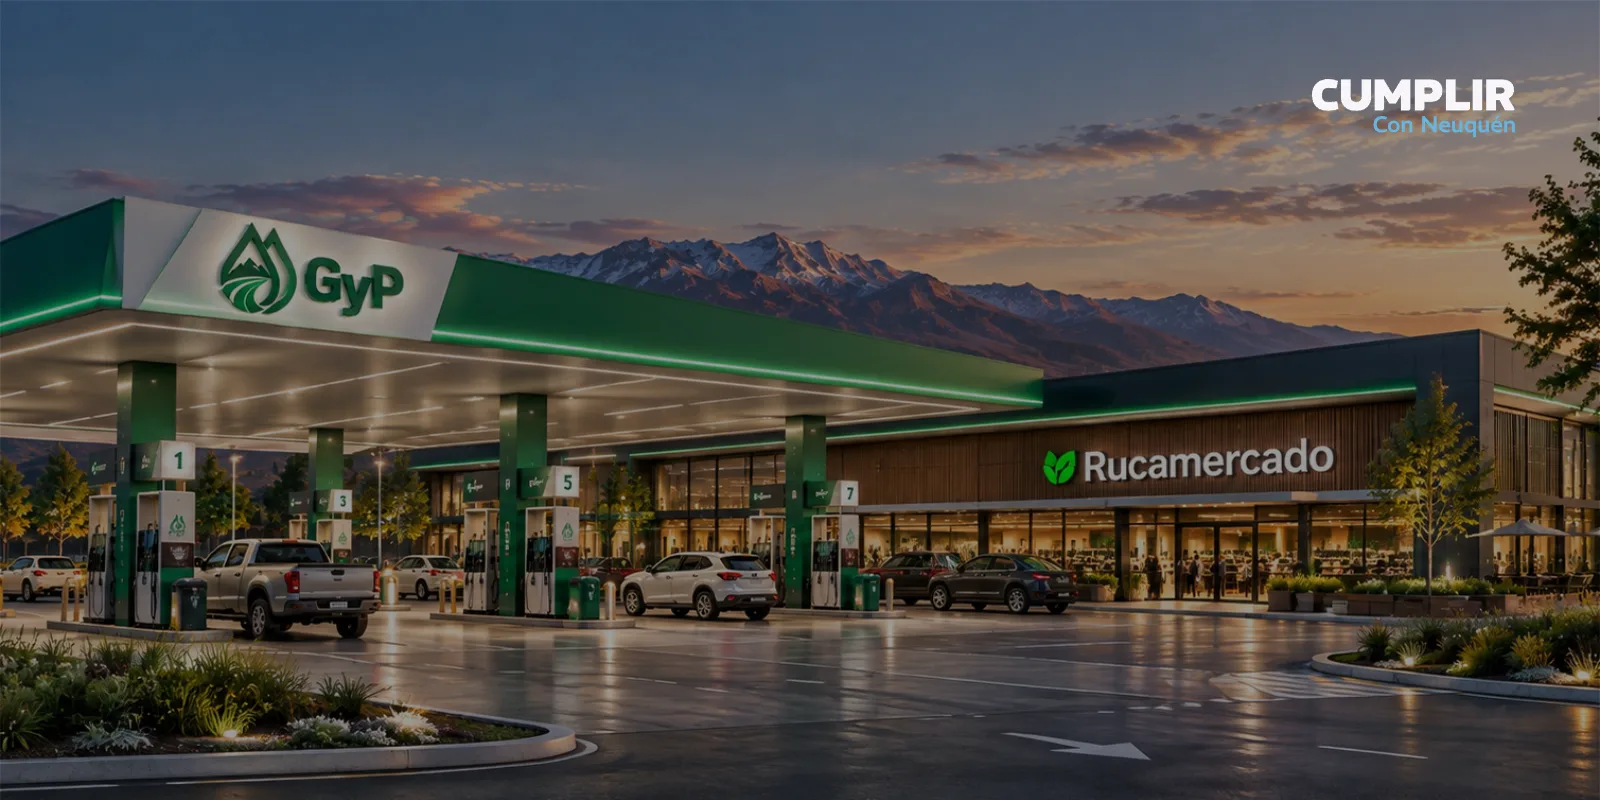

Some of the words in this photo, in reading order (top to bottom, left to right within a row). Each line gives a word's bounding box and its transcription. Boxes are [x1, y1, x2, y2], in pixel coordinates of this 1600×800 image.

[304, 257, 404, 317] GyP
[174, 451, 183, 469] 1
[1084, 438, 1334, 482] Rucamercado
[563, 474, 573, 490] 5
[340, 495, 347, 507] 3
[847, 487, 854, 500] 7
